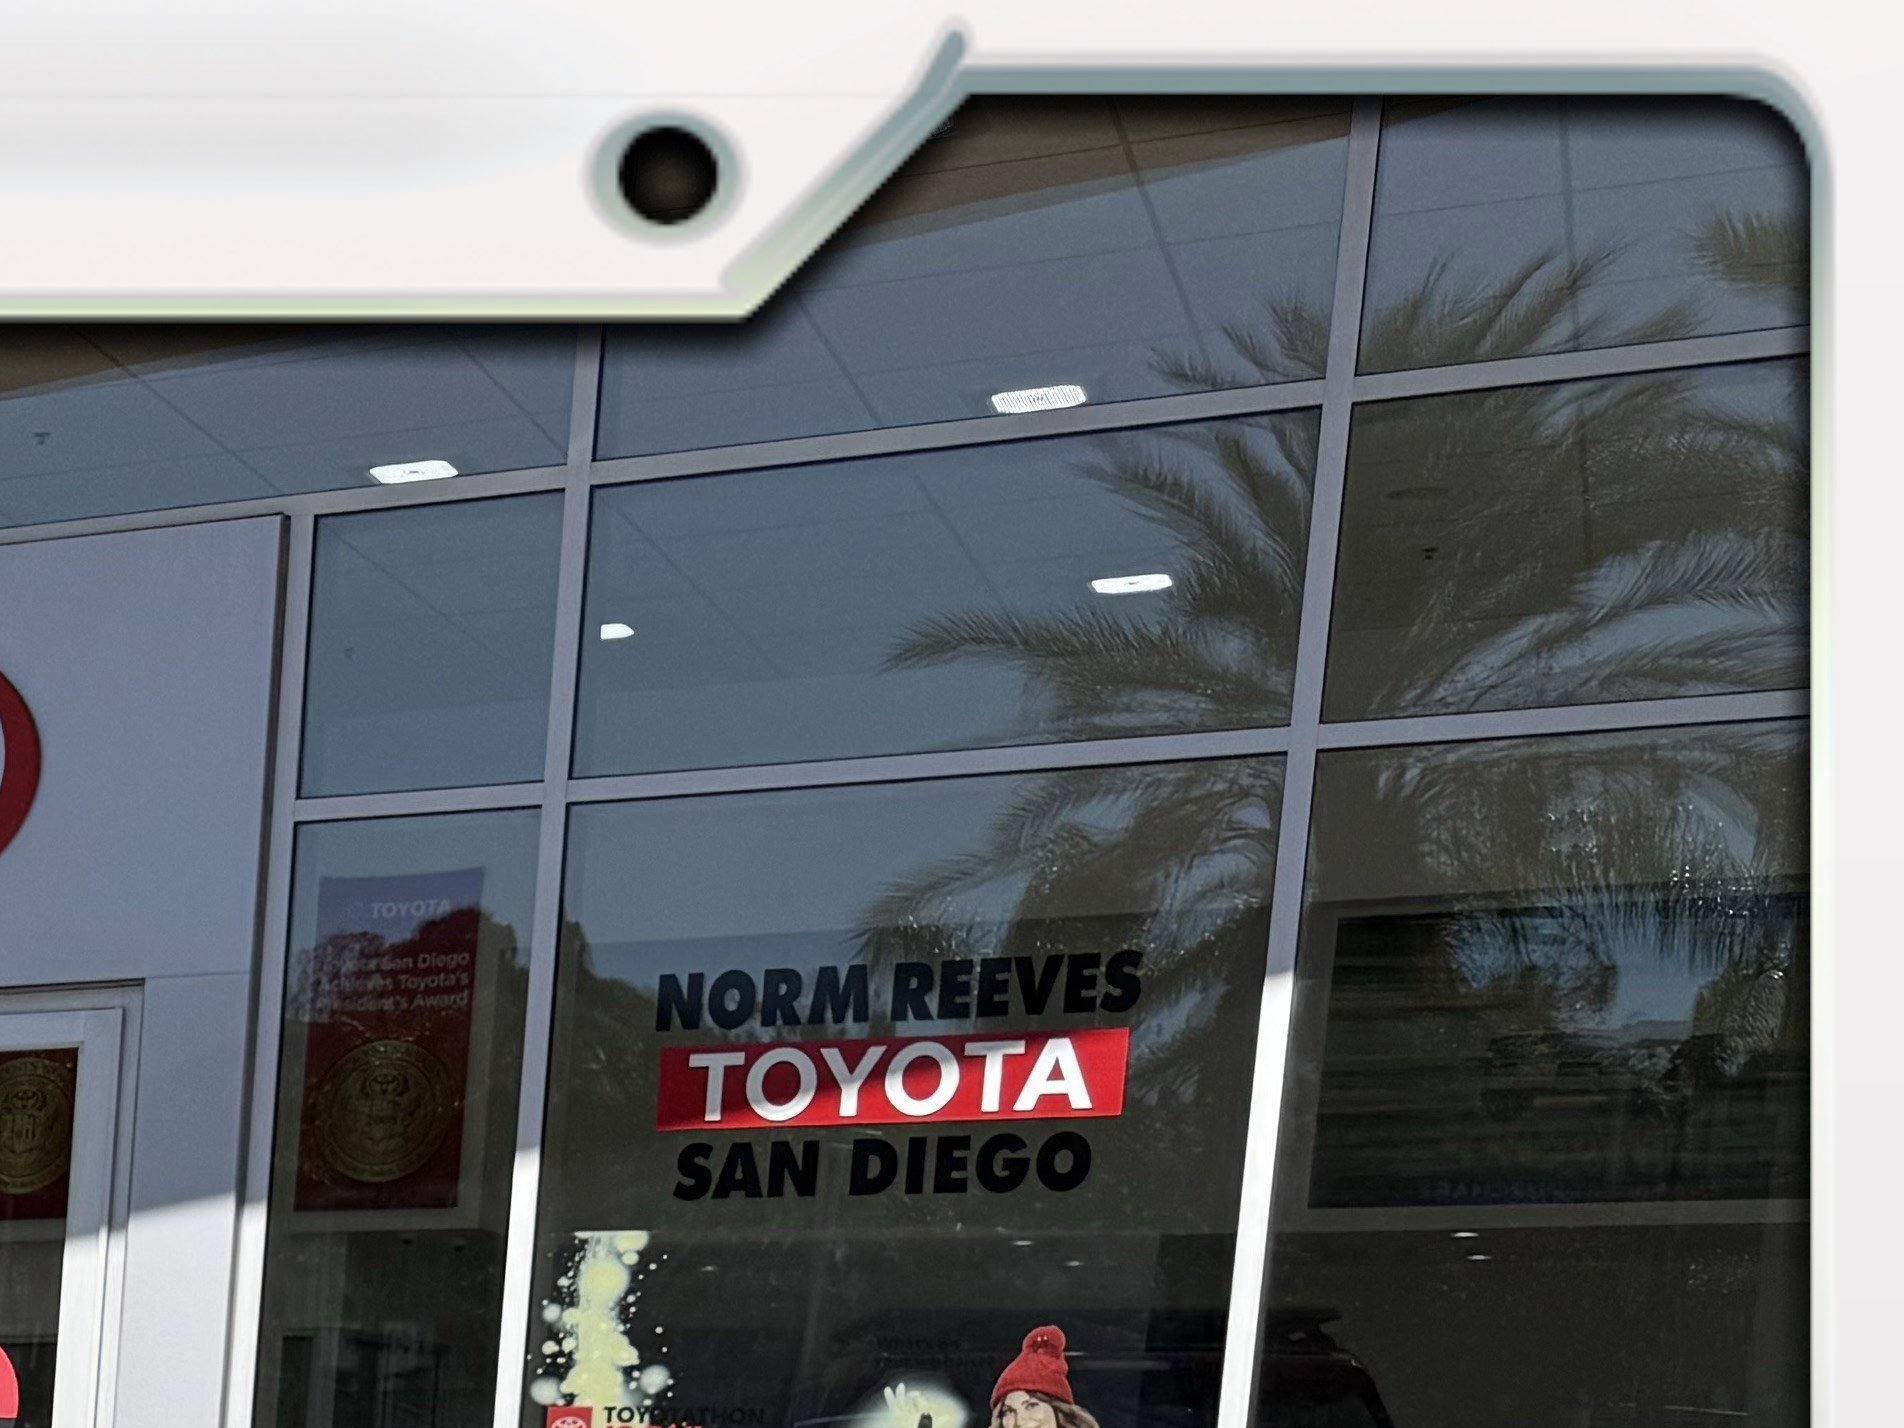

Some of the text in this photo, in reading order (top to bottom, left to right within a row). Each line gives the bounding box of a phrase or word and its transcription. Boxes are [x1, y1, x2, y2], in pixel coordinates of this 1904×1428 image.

[370, 899, 451, 920] TOYOTA
[417, 951, 470, 970] Diego
[398, 970, 470, 990] Toyota's
[410, 989, 469, 1011] Award
[655, 950, 1143, 1032] NORM REEVES
[688, 1036, 1094, 1122] TOYOTA
[672, 1130, 1093, 1200] SAN DIEGO
[604, 1406, 764, 1425] TOYOTATHON
